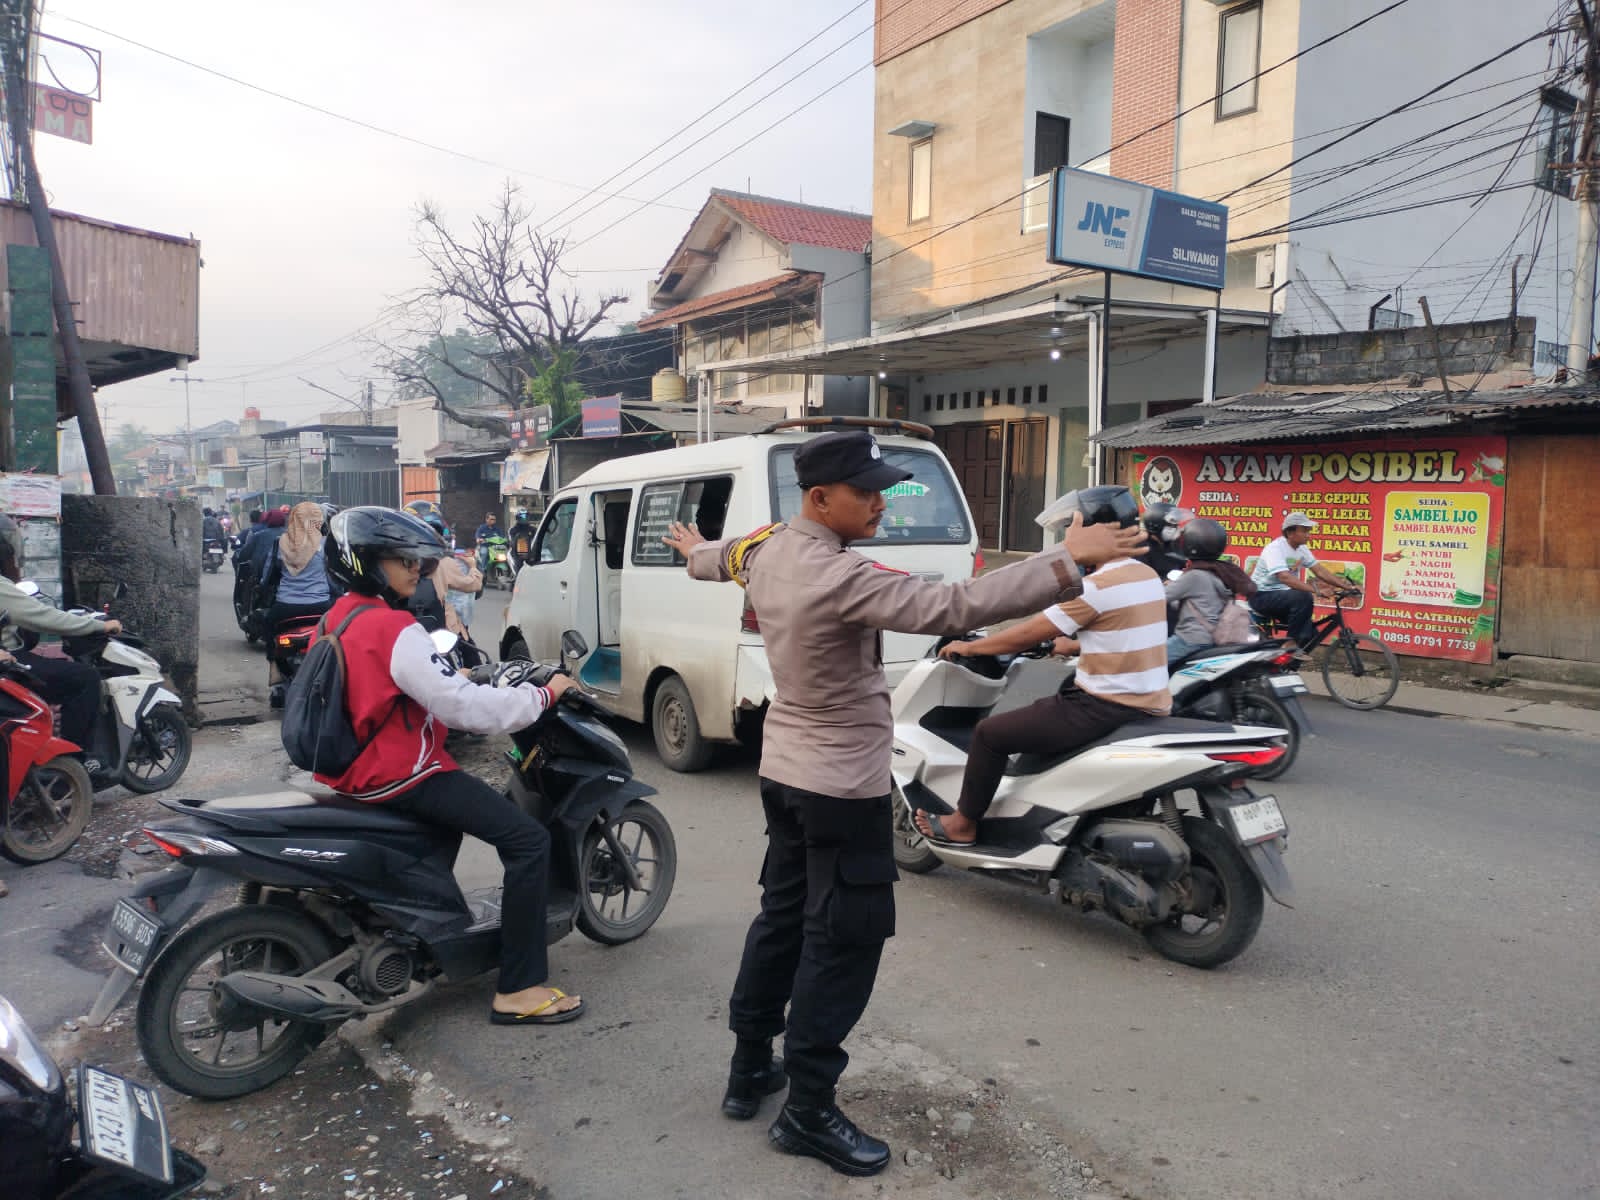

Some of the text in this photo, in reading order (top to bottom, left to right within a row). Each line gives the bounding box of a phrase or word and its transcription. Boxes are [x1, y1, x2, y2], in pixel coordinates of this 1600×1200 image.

[1172, 247, 1219, 267] SILIWANGI
[1196, 450, 1466, 483] AYAM POSIBEL
[1199, 491, 1233, 502] SEDIA
[1291, 493, 1370, 505] LELE GEPUK
[1418, 498, 1447, 506] SEDIA
[1198, 507, 1273, 518] AYAM GEPUK
[1394, 508, 1478, 523] SAMBEL IJO
[1234, 521, 1268, 533] AYAM
[1323, 524, 1370, 537] BAKAR
[1393, 523, 1477, 535] SAMBEL BAWANG
[1325, 540, 1372, 553] BAKAR
[1429, 540, 1469, 549] SAMBEL
[1371, 608, 1476, 625] TERIMA CATERING
[1424, 623, 1474, 635] DELIVERY
[1383, 632, 1410, 644] 0895
